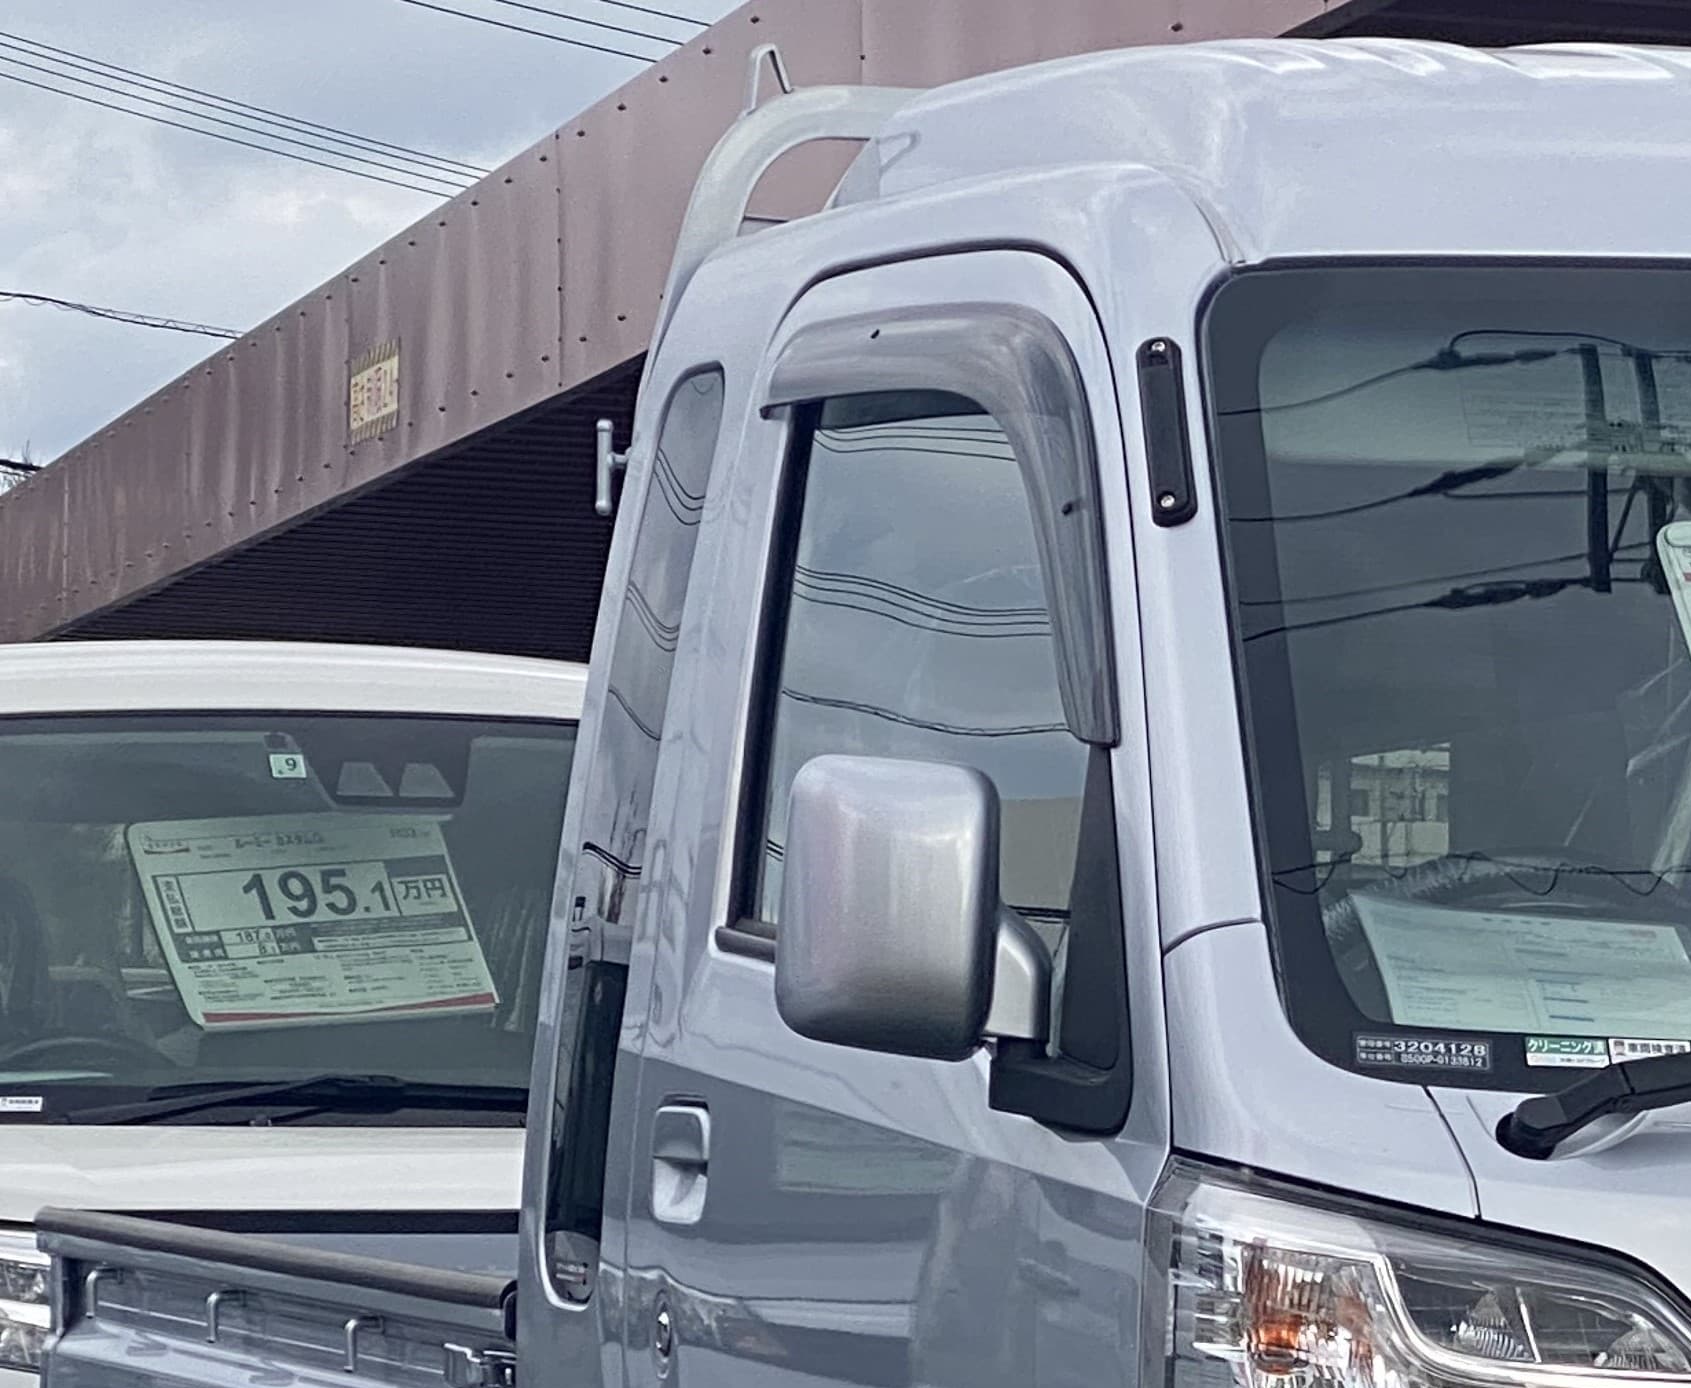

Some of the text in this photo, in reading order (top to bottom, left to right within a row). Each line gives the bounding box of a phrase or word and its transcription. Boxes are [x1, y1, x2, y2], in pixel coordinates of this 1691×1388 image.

[241, 867, 449, 921] 195.1 万円
[1394, 1041, 1486, 1057] 3204128
